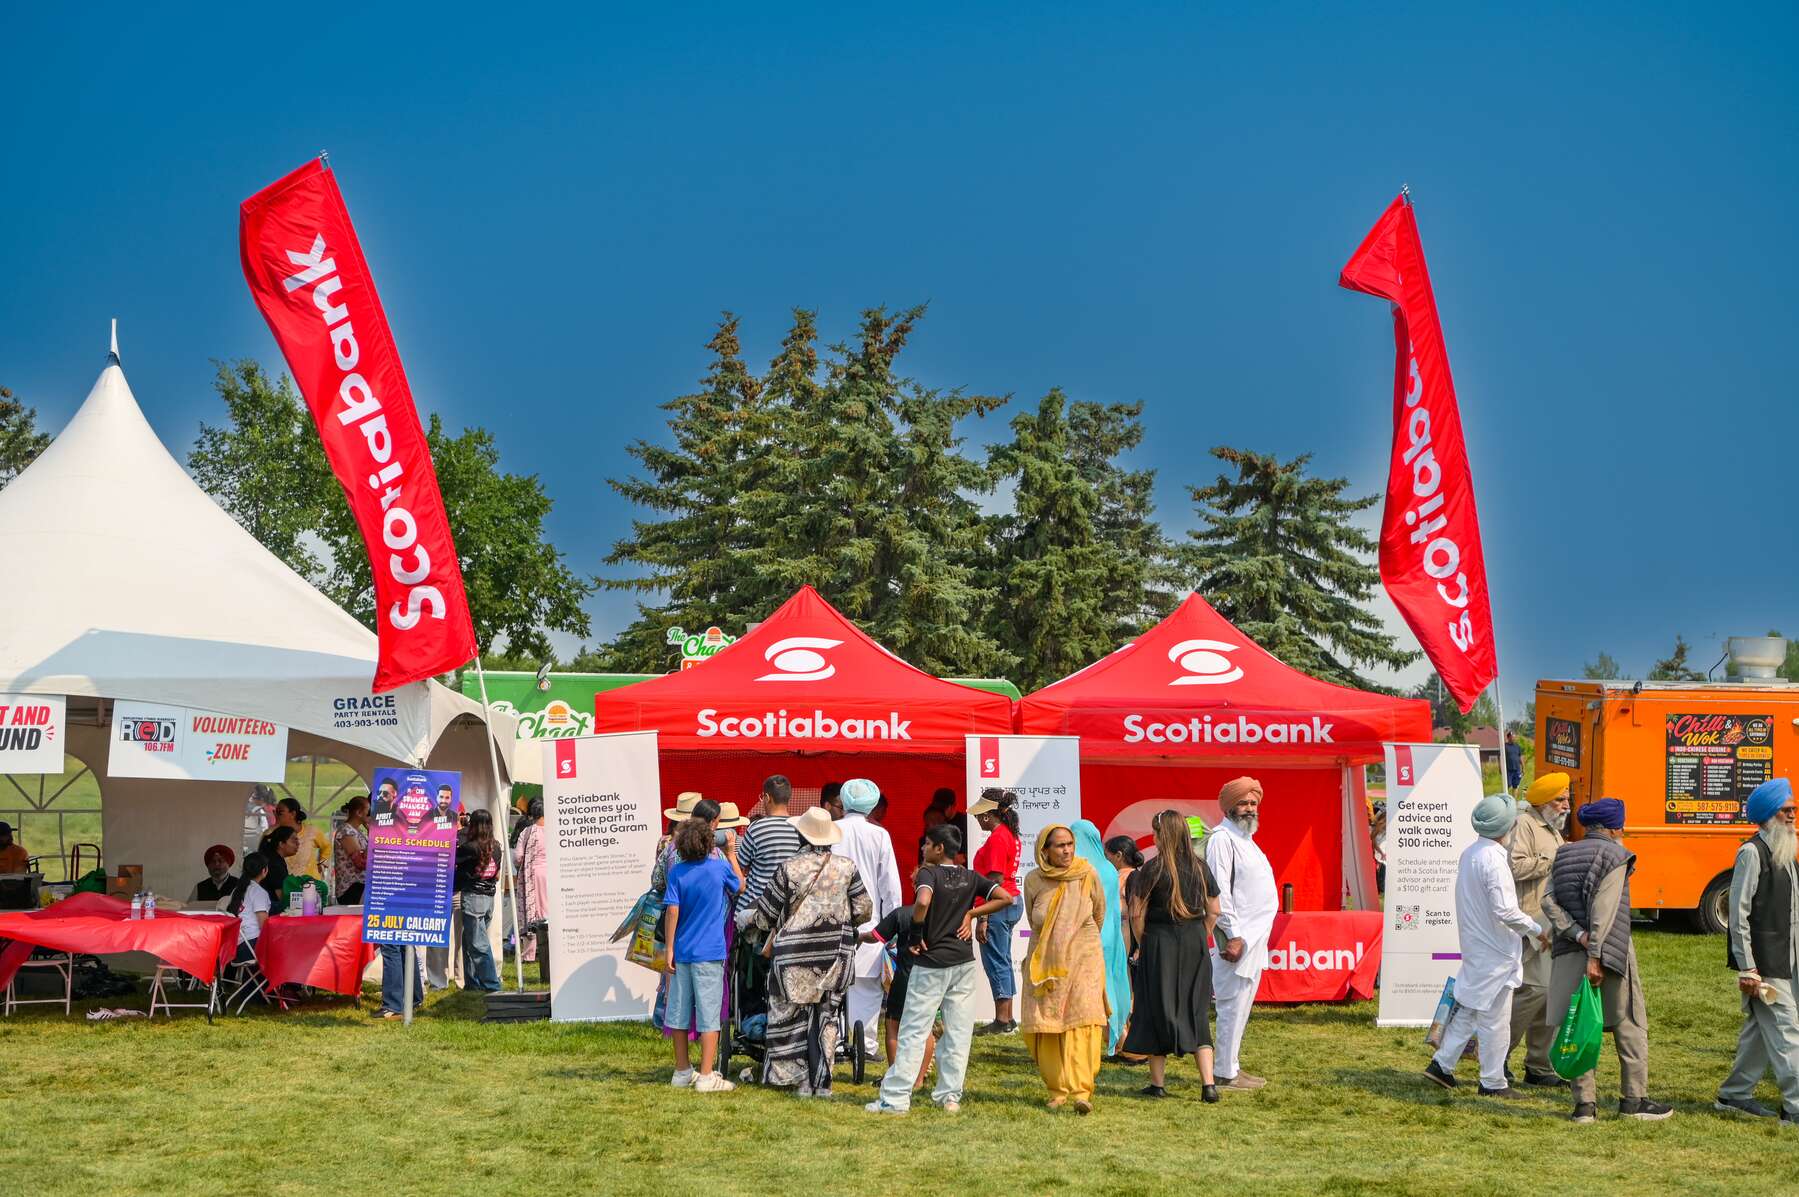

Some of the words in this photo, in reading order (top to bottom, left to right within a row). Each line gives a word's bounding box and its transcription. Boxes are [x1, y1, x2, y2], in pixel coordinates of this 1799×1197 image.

[283, 233, 446, 633] Scotiabank
[1402, 339, 1474, 652] Scotiaba
[333, 695, 395, 710] GRACE
[11, 706, 50, 725] AND
[334, 710, 359, 718] PARTY
[361, 709, 397, 717] RENTALS
[192, 716, 277, 736] VOLUNTEERS
[334, 718, 398, 728] 403-903-1000
[696, 709, 912, 740] Scotiabank
[1123, 715, 1335, 743] Scotiabank
[1674, 715, 1728, 737] Chilli
[1724, 719, 1732, 729] &
[1681, 731, 1720, 746] Wok
[213, 743, 251, 760] ZONE
[557, 792, 620, 805] Scotiabank
[558, 804, 614, 815] welcomes
[615, 803, 637, 813] you
[1398, 800, 1415, 810] Get
[1417, 802, 1448, 812] expert
[559, 817, 570, 826] to
[572, 815, 597, 825] take
[599, 813, 622, 824] part
[624, 812, 635, 821] in
[1398, 813, 1431, 822] advice
[1433, 813, 1452, 823] and
[559, 828, 577, 836] our
[579, 825, 607, 835] Pithu
[609, 823, 648, 833] Garam
[1398, 826, 1422, 835] walk
[1424, 827, 1452, 837] away
[374, 836, 402, 845] STAGE
[405, 838, 451, 849] SCHEDULE
[559, 837, 620, 848] Challenge.
[1398, 837, 1420, 848] $100
[1422, 838, 1452, 847] richer.
[1418, 866, 1438, 874] Scotia
[1402, 884, 1419, 892] $100
[367, 914, 380, 928] 25
[382, 915, 404, 929] JULY
[406, 916, 447, 931] CALGARY
[1425, 918, 1453, 926] register.
[367, 930, 393, 940] FREE
[395, 931, 445, 943] FESTIVAL
[1263, 941, 1364, 971] aban
